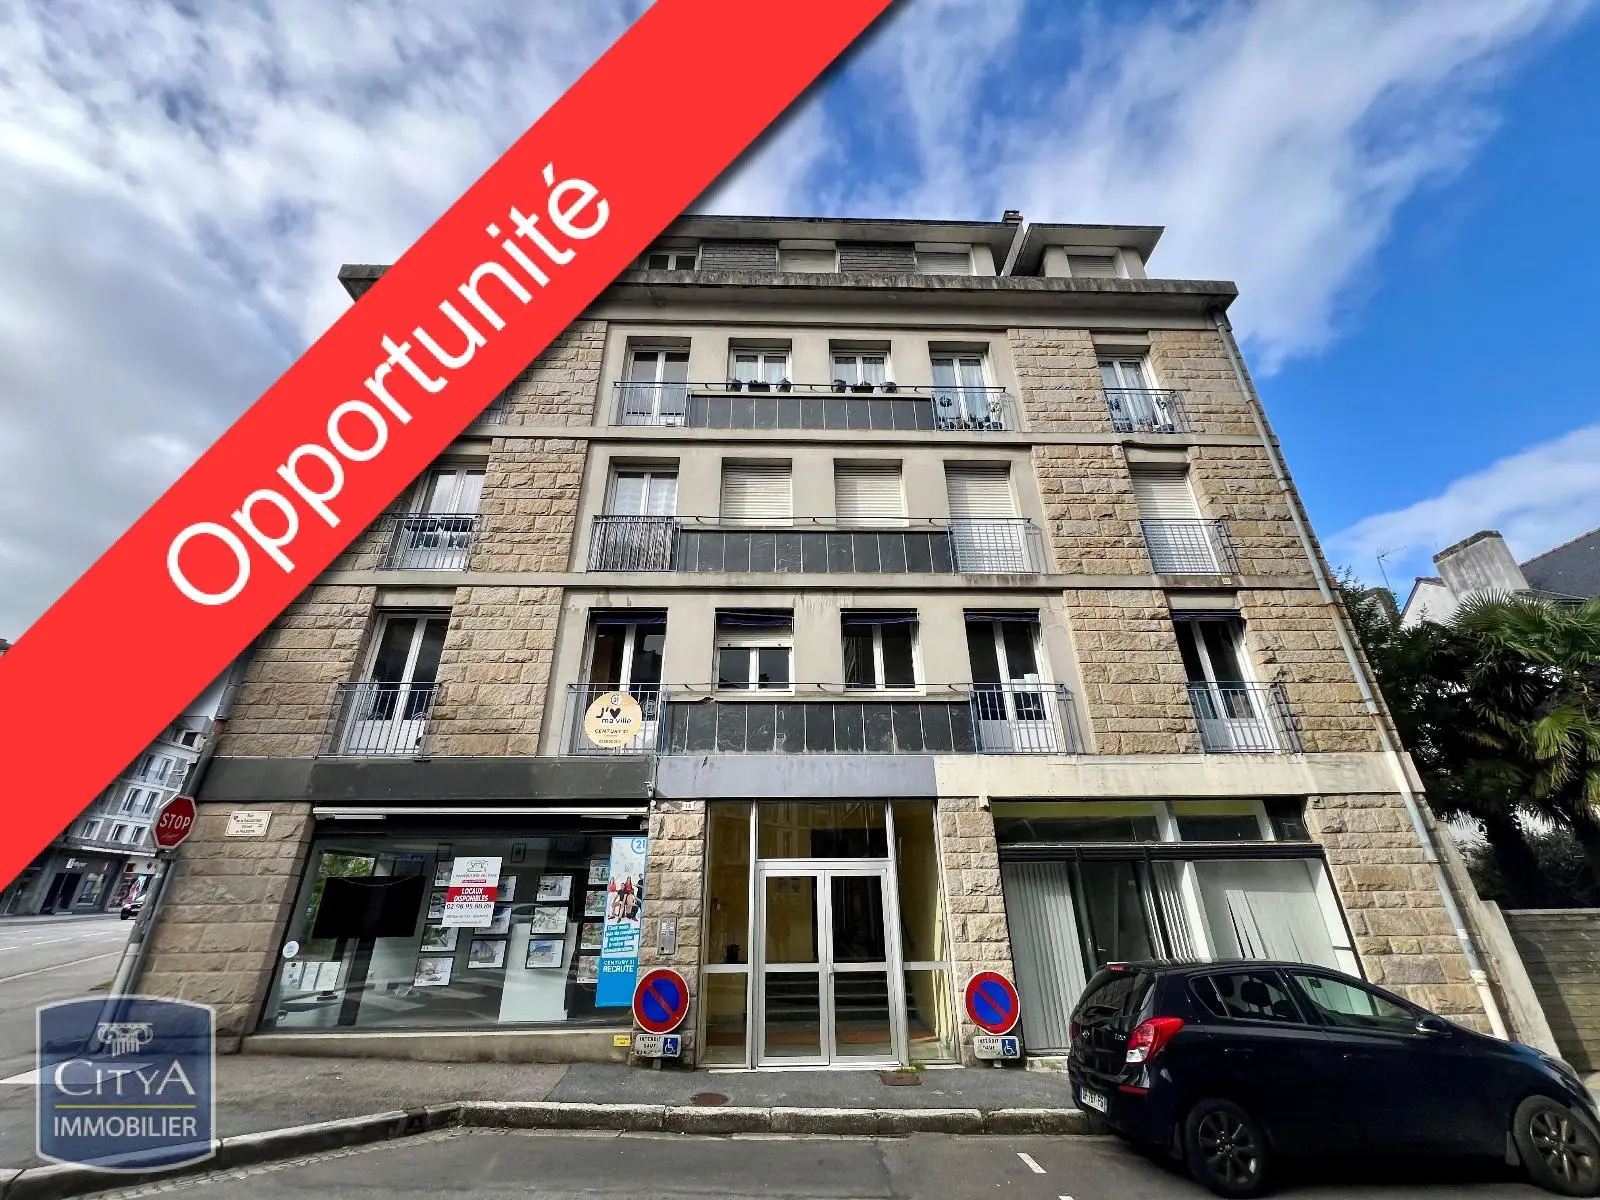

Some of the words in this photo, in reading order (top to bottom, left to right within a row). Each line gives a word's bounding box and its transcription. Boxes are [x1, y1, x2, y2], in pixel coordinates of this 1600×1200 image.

[160, 811, 191, 830] STOP
[461, 887, 484, 895] LOCAUX
[453, 894, 489, 902] DISPONIBLES
[603, 965, 635, 973] RECRUTE
